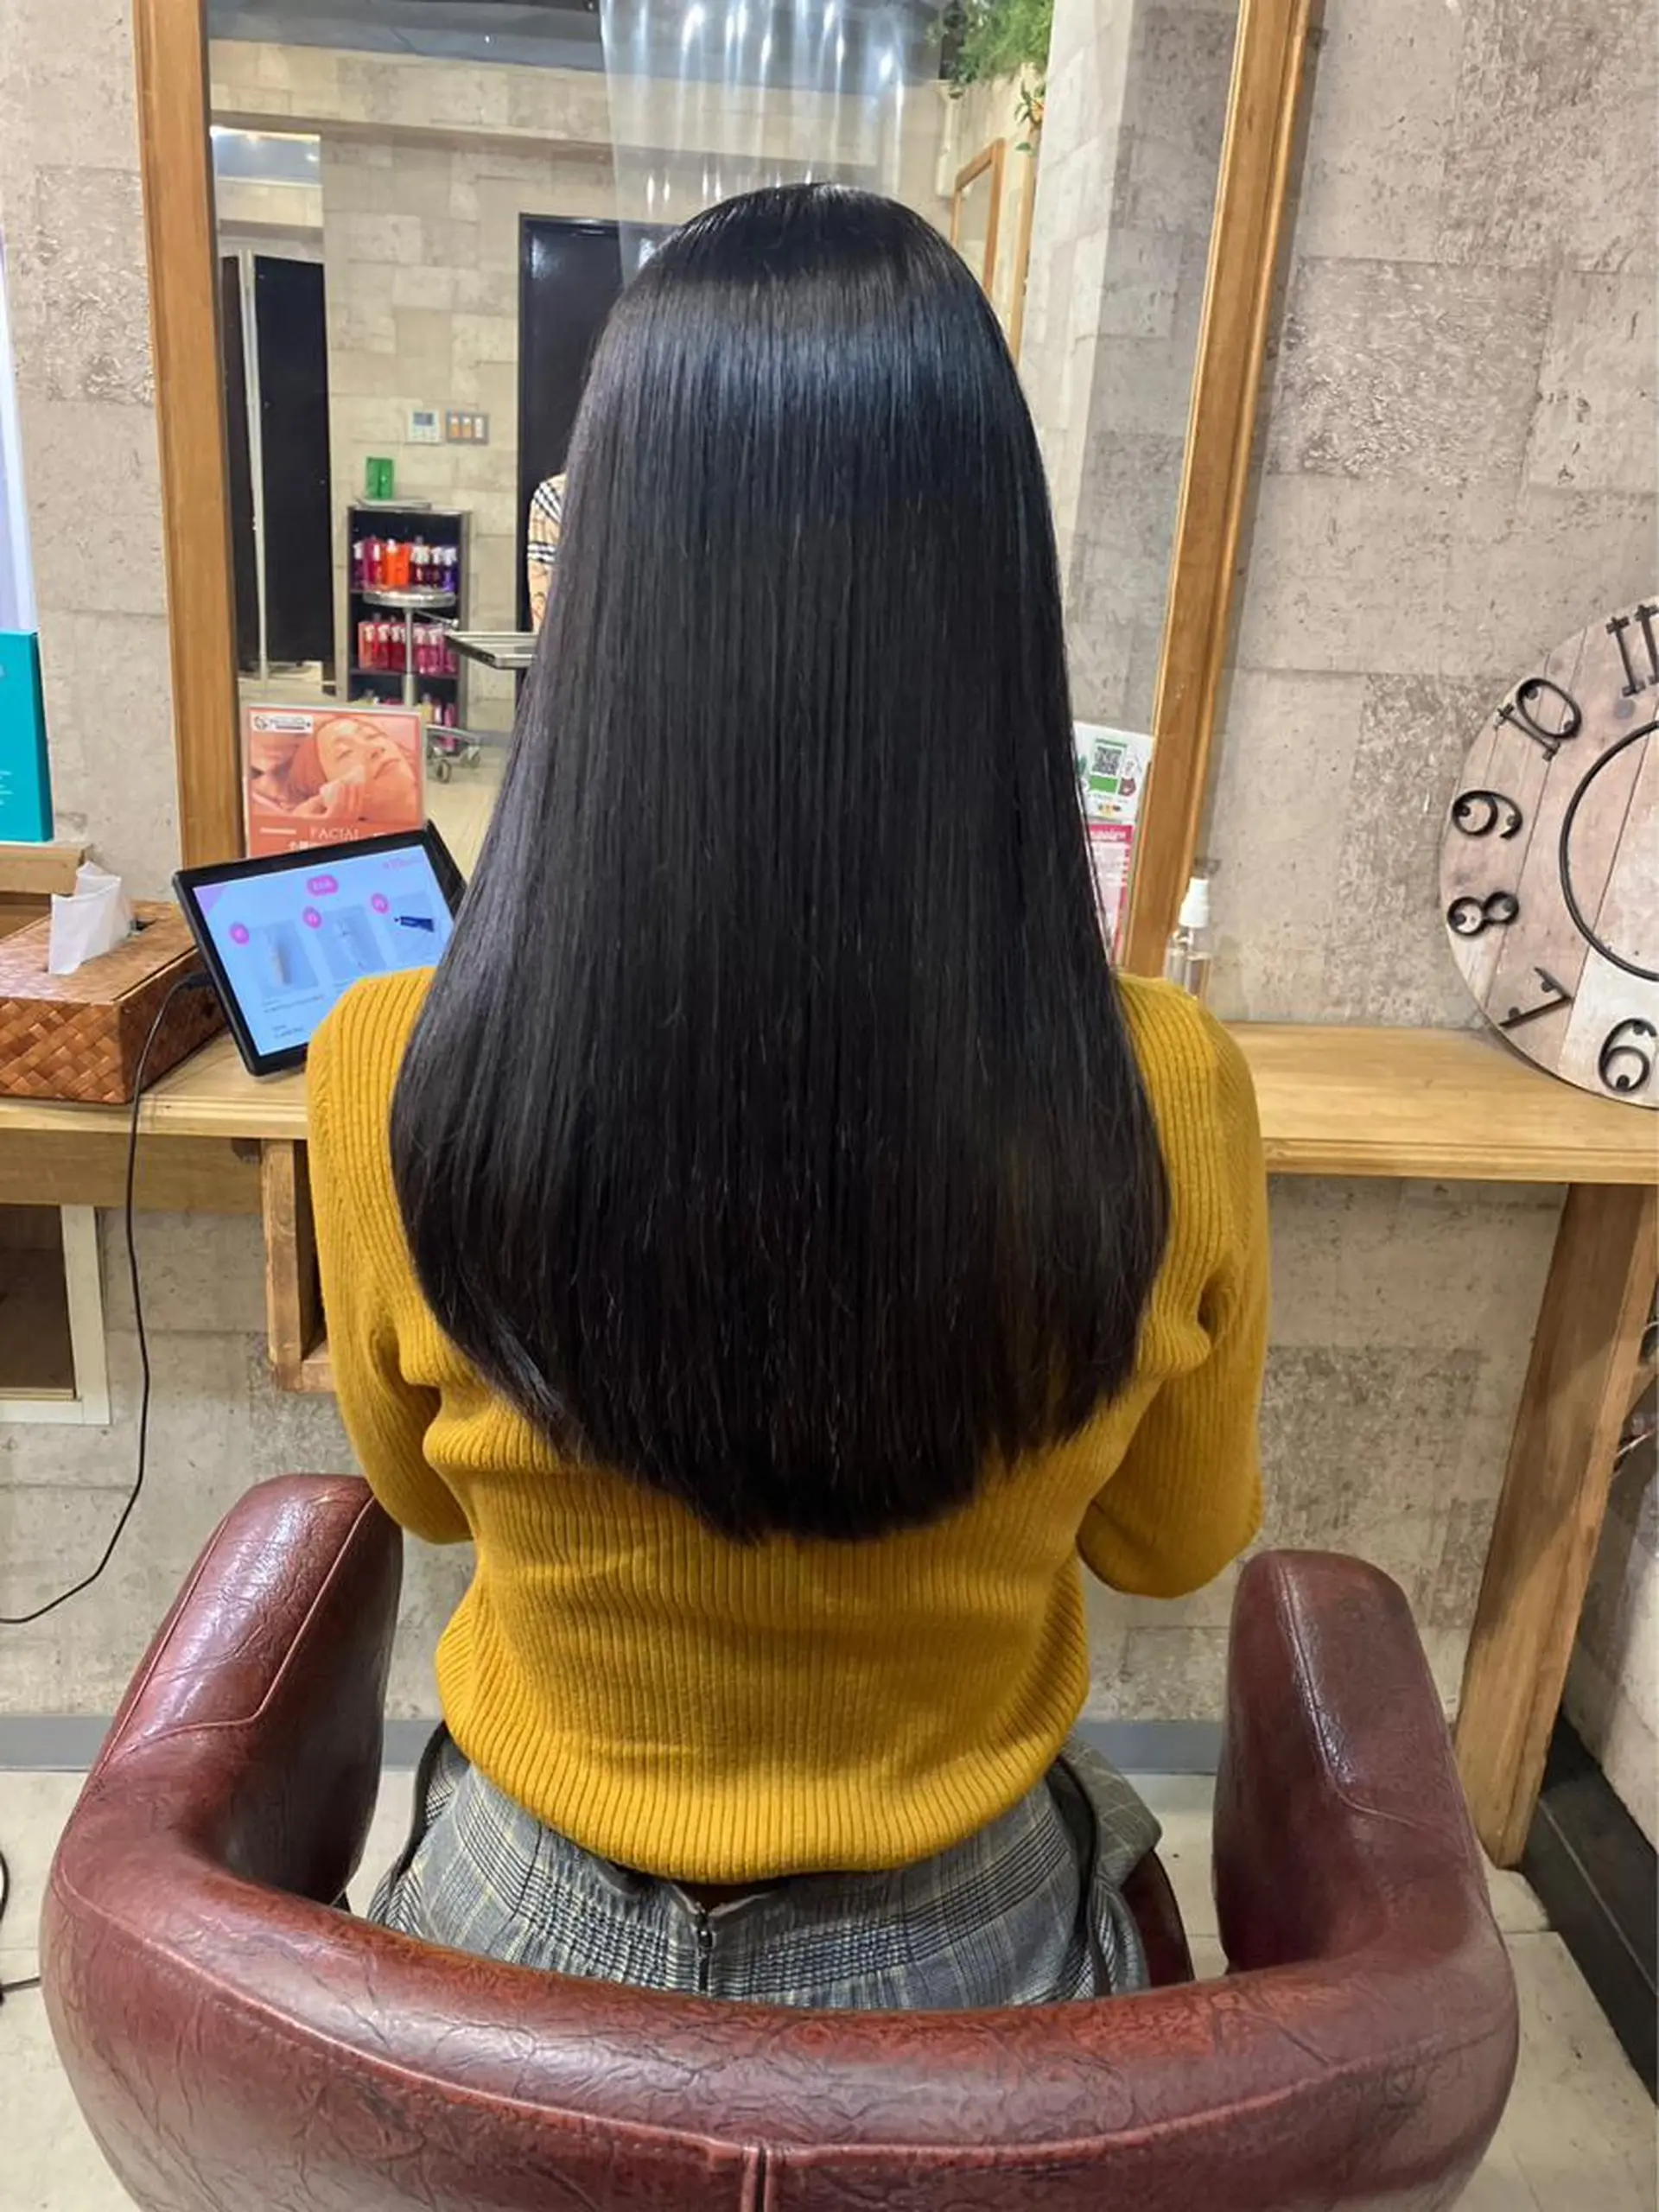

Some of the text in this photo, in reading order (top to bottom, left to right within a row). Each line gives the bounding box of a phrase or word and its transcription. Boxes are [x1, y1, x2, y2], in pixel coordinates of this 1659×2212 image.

[1496, 677, 1582, 760] 10
[1452, 790, 1522, 839] 9
[1446, 891, 1519, 935] 8
[1498, 967, 1573, 1028] 7
[1598, 1018, 1658, 1092] 6
